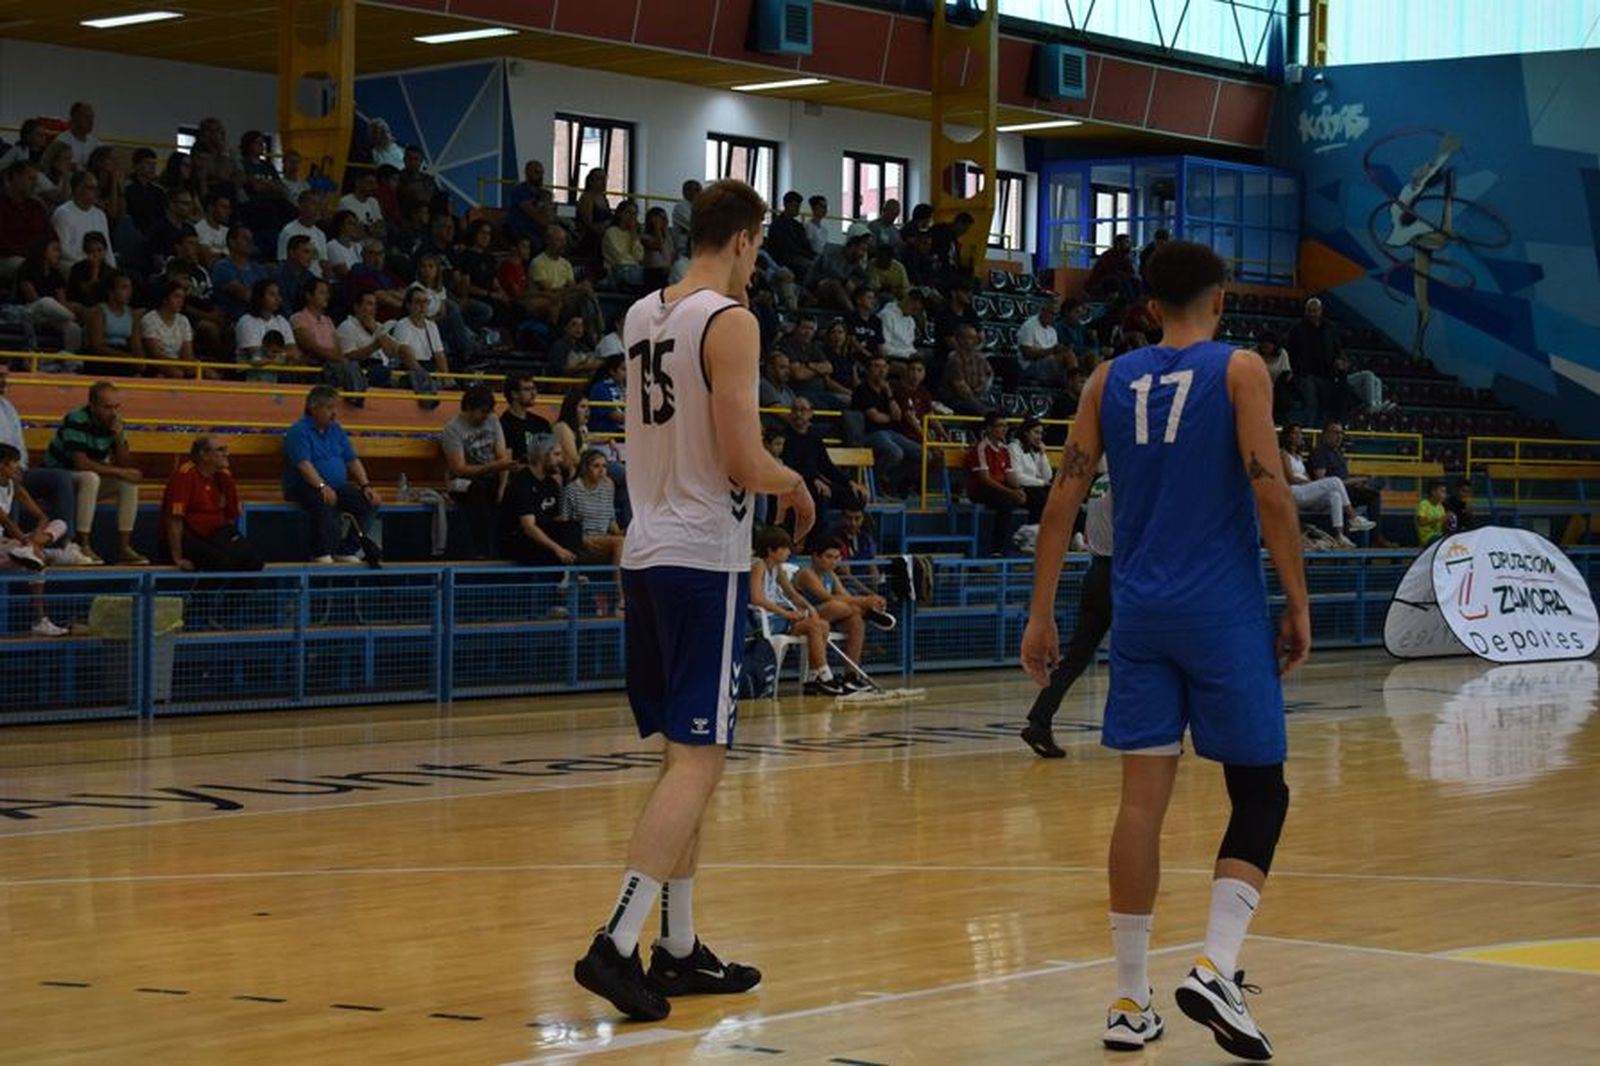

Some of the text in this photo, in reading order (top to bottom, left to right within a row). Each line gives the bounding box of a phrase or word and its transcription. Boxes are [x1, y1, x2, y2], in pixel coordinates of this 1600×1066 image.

[628, 339, 676, 424] 15
[1129, 369, 1194, 445] 17
[1492, 585, 1572, 615] ZAMORA
[1469, 629, 1585, 655] Deportes
